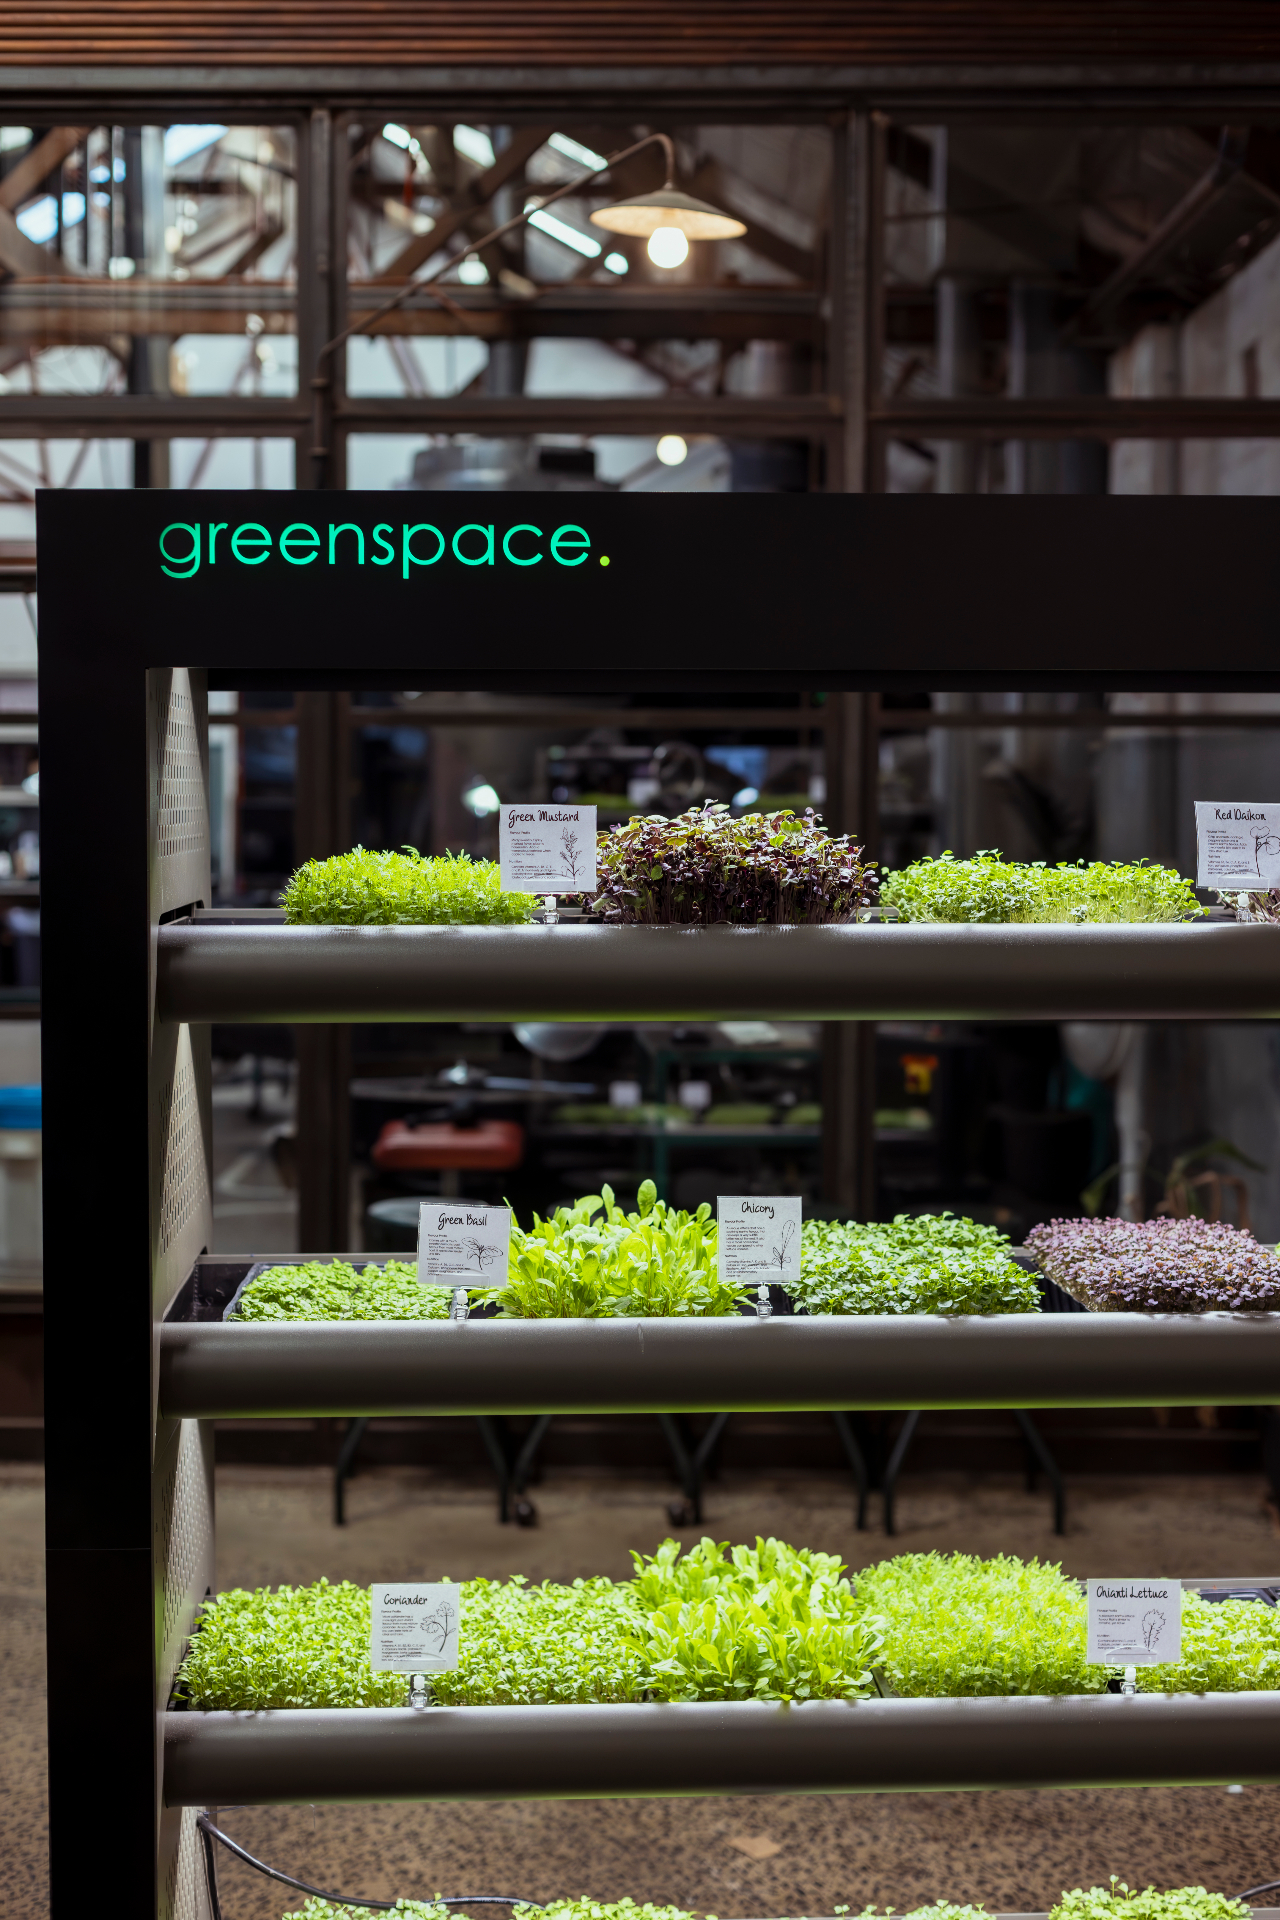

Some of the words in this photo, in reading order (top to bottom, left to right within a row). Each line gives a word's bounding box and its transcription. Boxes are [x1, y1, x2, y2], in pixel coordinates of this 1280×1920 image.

[159, 522, 611, 580] greenspace.
[508, 809, 536, 829] Green
[538, 809, 580, 822] Mustard
[1214, 808, 1233, 821] Red
[1234, 808, 1267, 821] Daikon
[741, 1201, 775, 1220] Chicory
[437, 1212, 465, 1231] Green
[466, 1213, 488, 1227] Basil
[383, 1593, 428, 1606] Coriander
[1096, 1585, 1128, 1599] Chianti
[1129, 1585, 1169, 1599] Lettuce
